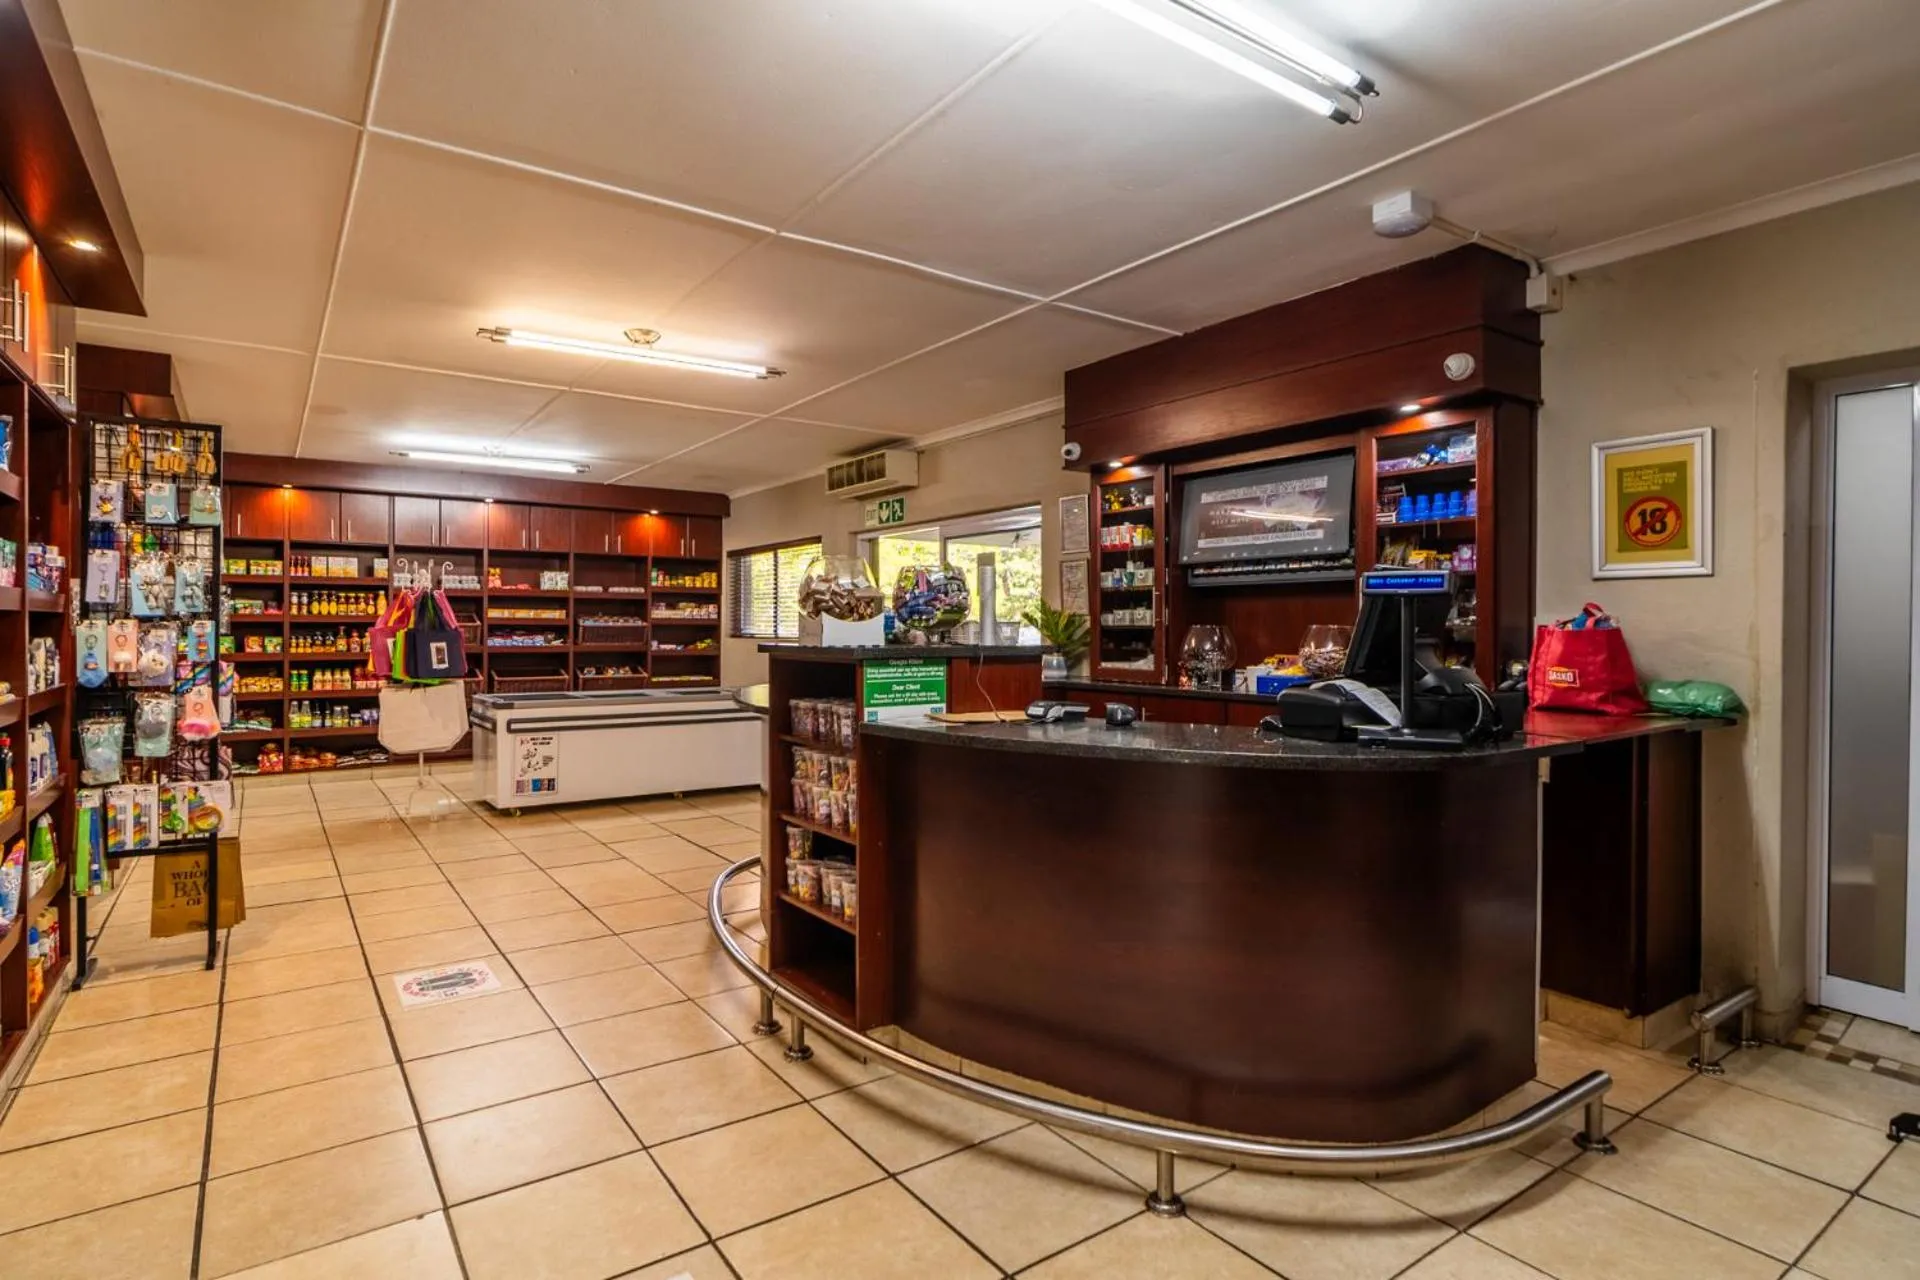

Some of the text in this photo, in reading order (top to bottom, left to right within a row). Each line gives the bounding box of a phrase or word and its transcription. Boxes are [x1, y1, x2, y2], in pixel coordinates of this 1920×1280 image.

[1637, 507, 1668, 536] 18
[193, 860, 201, 869] A
[171, 870, 209, 880] WHO
